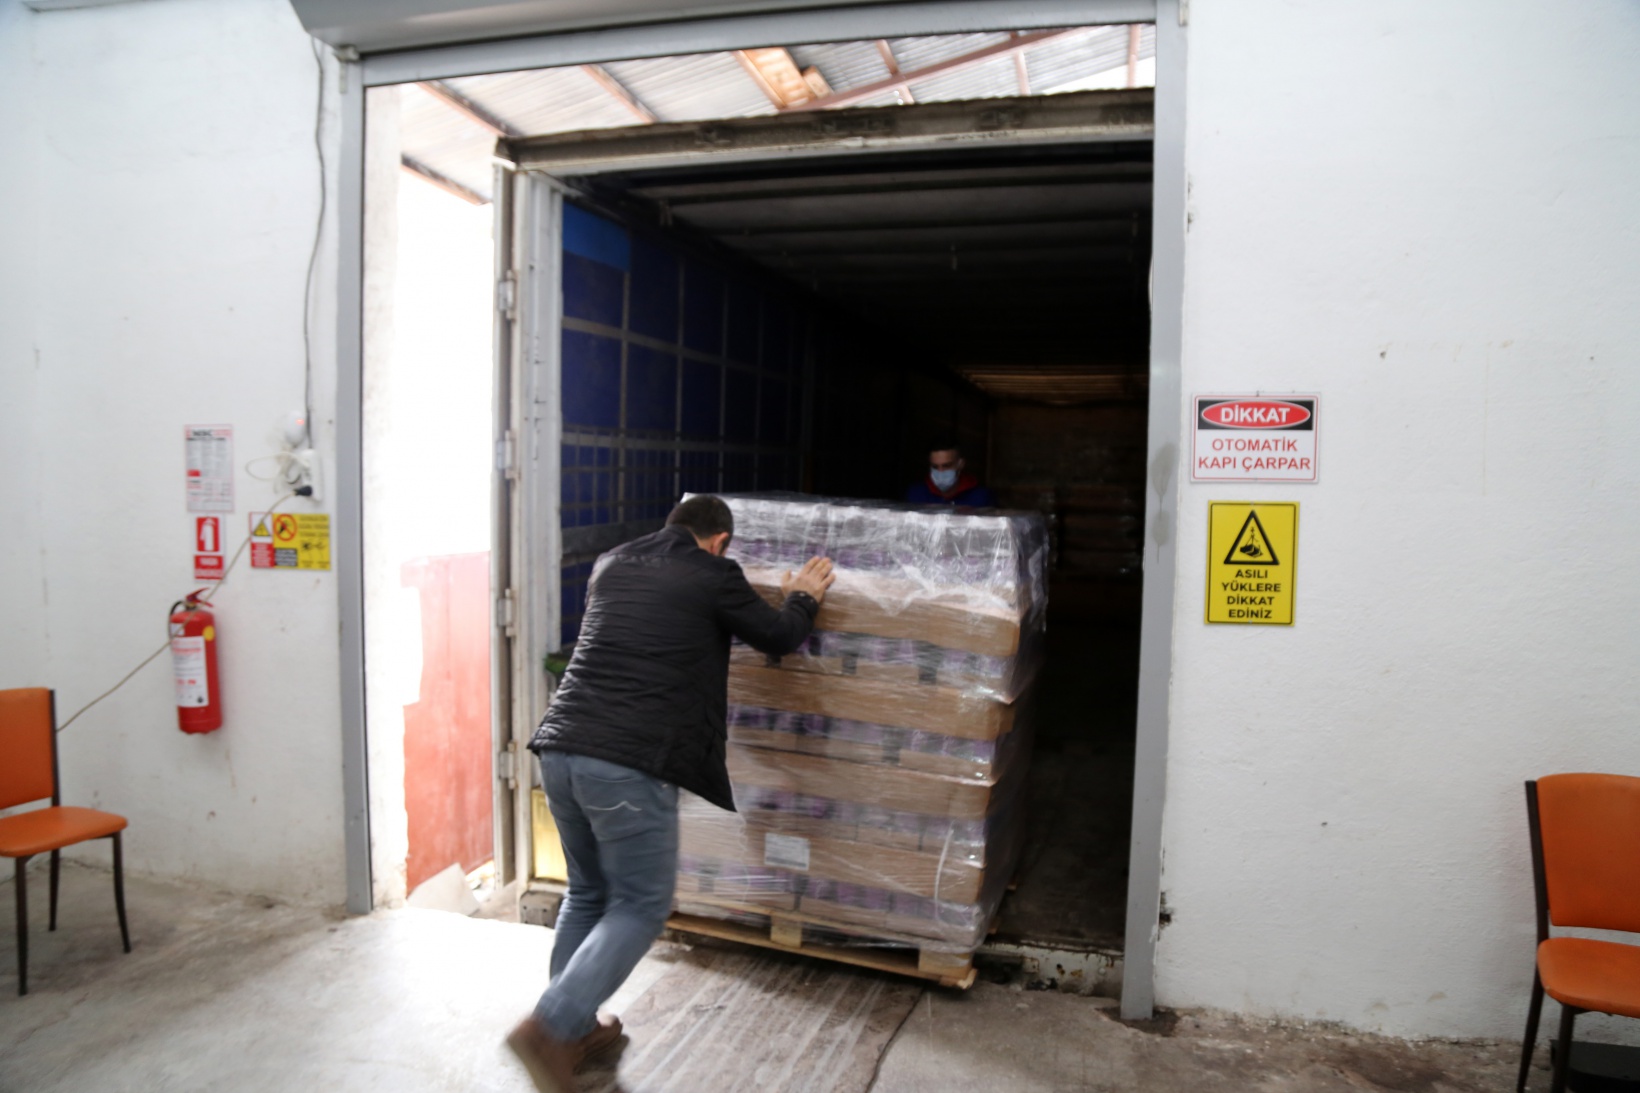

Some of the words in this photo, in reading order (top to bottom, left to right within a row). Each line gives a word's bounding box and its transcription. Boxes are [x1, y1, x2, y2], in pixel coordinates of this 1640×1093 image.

[1220, 404, 1290, 423] DİKKAT
[1212, 436, 1298, 452] OTOMATİK
[1198, 457, 1237, 470] KAPI
[1241, 456, 1311, 473] ÇARPAR
[1235, 569, 1269, 579] ASILI
[1221, 580, 1282, 593] YÜKLERE
[1226, 595, 1275, 606] DİKKAT
[1228, 608, 1273, 619] EDİNİZ
